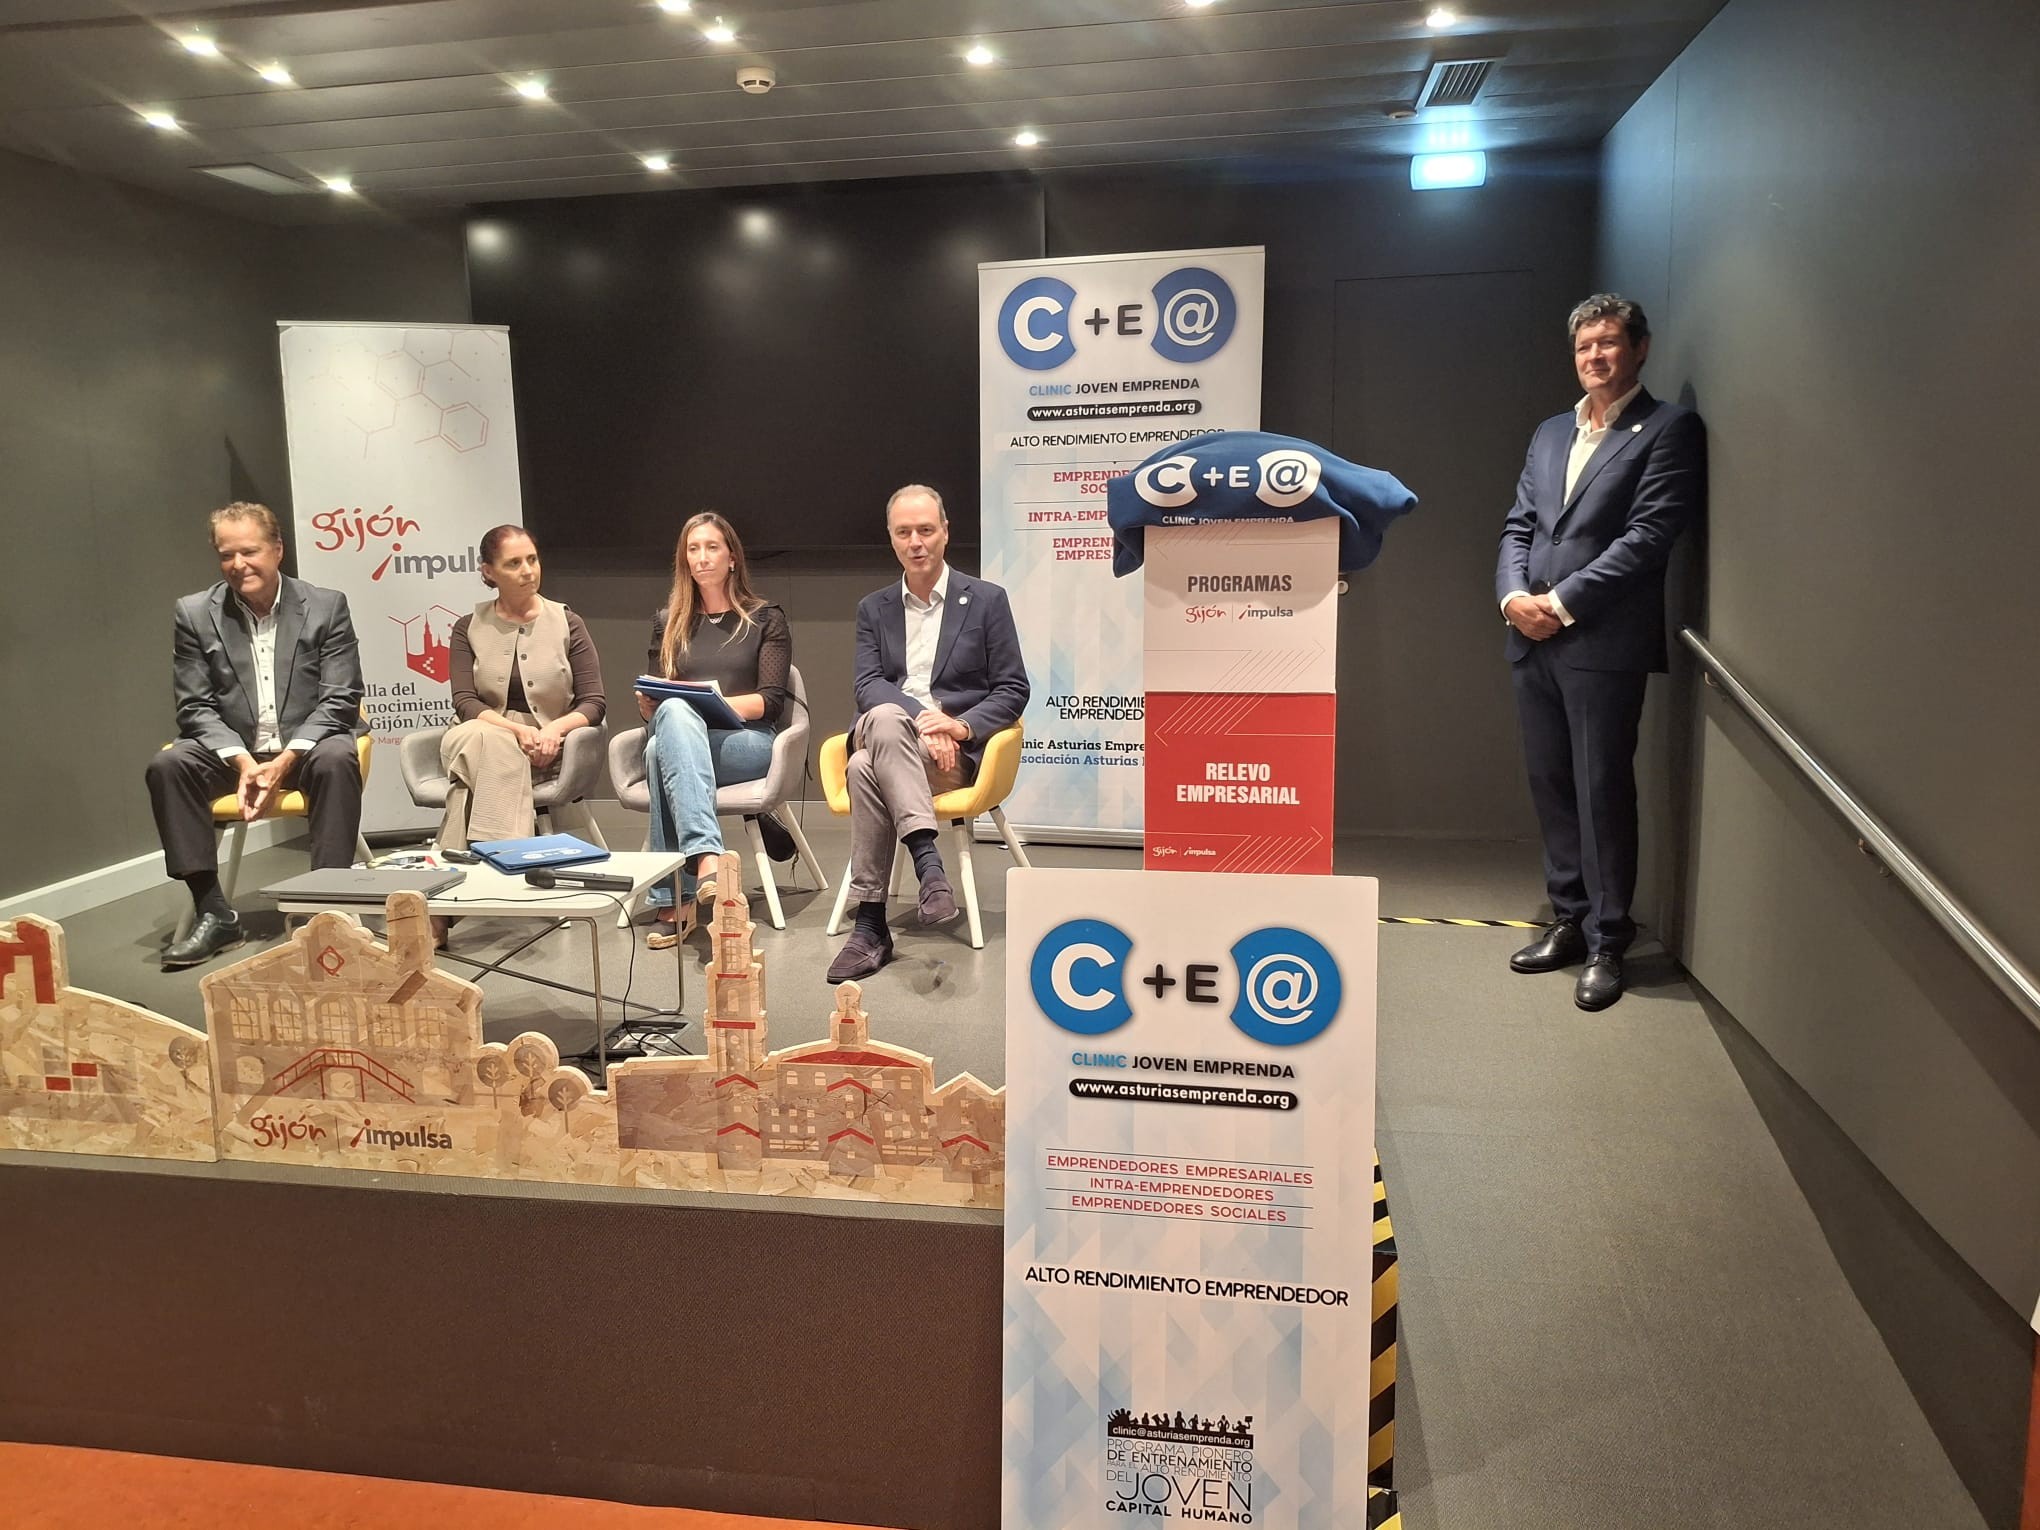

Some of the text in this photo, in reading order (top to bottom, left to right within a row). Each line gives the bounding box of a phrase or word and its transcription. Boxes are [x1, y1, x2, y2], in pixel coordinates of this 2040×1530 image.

[1029, 378, 1201, 397] CLINIC JOVEN EMPRENDA
[1031, 400, 1196, 418] www.asturiasemprenda.org
[1010, 428, 1225, 448] ALTO RENDIMIENTO EMPRENDE
[1027, 511, 1107, 523] INTRA-EMP
[1161, 515, 1196, 526] CLINIC
[311, 504, 421, 553] gijón
[1052, 537, 1113, 549] EMPREN
[1055, 550, 1113, 561] EMPRES
[1187, 574, 1293, 593] PROGRAMAS
[1184, 604, 1293, 624] gijón impulsa
[392, 681, 416, 696] del
[366, 698, 455, 714] nocimient
[1045, 695, 1080, 708] ALTO
[1047, 739, 1101, 751] Asturias
[1020, 753, 1079, 765] sociación
[1084, 754, 1139, 767] Asturias
[1205, 763, 1271, 782] RELEVO
[1176, 784, 1300, 805] EMPRESARIAL
[1183, 846, 1217, 857] impulsa
[1071, 1052, 1295, 1079] CLINIC JOVEN EMPRENDA
[1075, 1082, 1290, 1109] www.asturiasemprenda.org
[250, 1114, 453, 1150] gijón impulsa
[1047, 1155, 1313, 1185] EMPRENDEDORES EMPRESARIALES
[1090, 1177, 1275, 1202] INTRA-EMPRENDEDORES
[1071, 1195, 1287, 1222] EMPRENDEDORES SOCIALES
[1025, 1266, 1349, 1307] ALTO RENDIMIENTO EMPRENDEDOR
[1112, 1426, 1251, 1448] clinic@asturiasemprenda.org
[1107, 1438, 1253, 1462] PROGRAMA PIONERO
[1107, 1449, 1253, 1473] DE ENTRENAMIENTO
[1107, 1461, 1127, 1469] PARA
[1140, 1463, 1170, 1475] ALTO
[1174, 1468, 1252, 1482] RENDIMIENTO
[1106, 1470, 1252, 1512] DEL JOVEN
[1105, 1500, 1253, 1524] CAPITAL HUMANO
